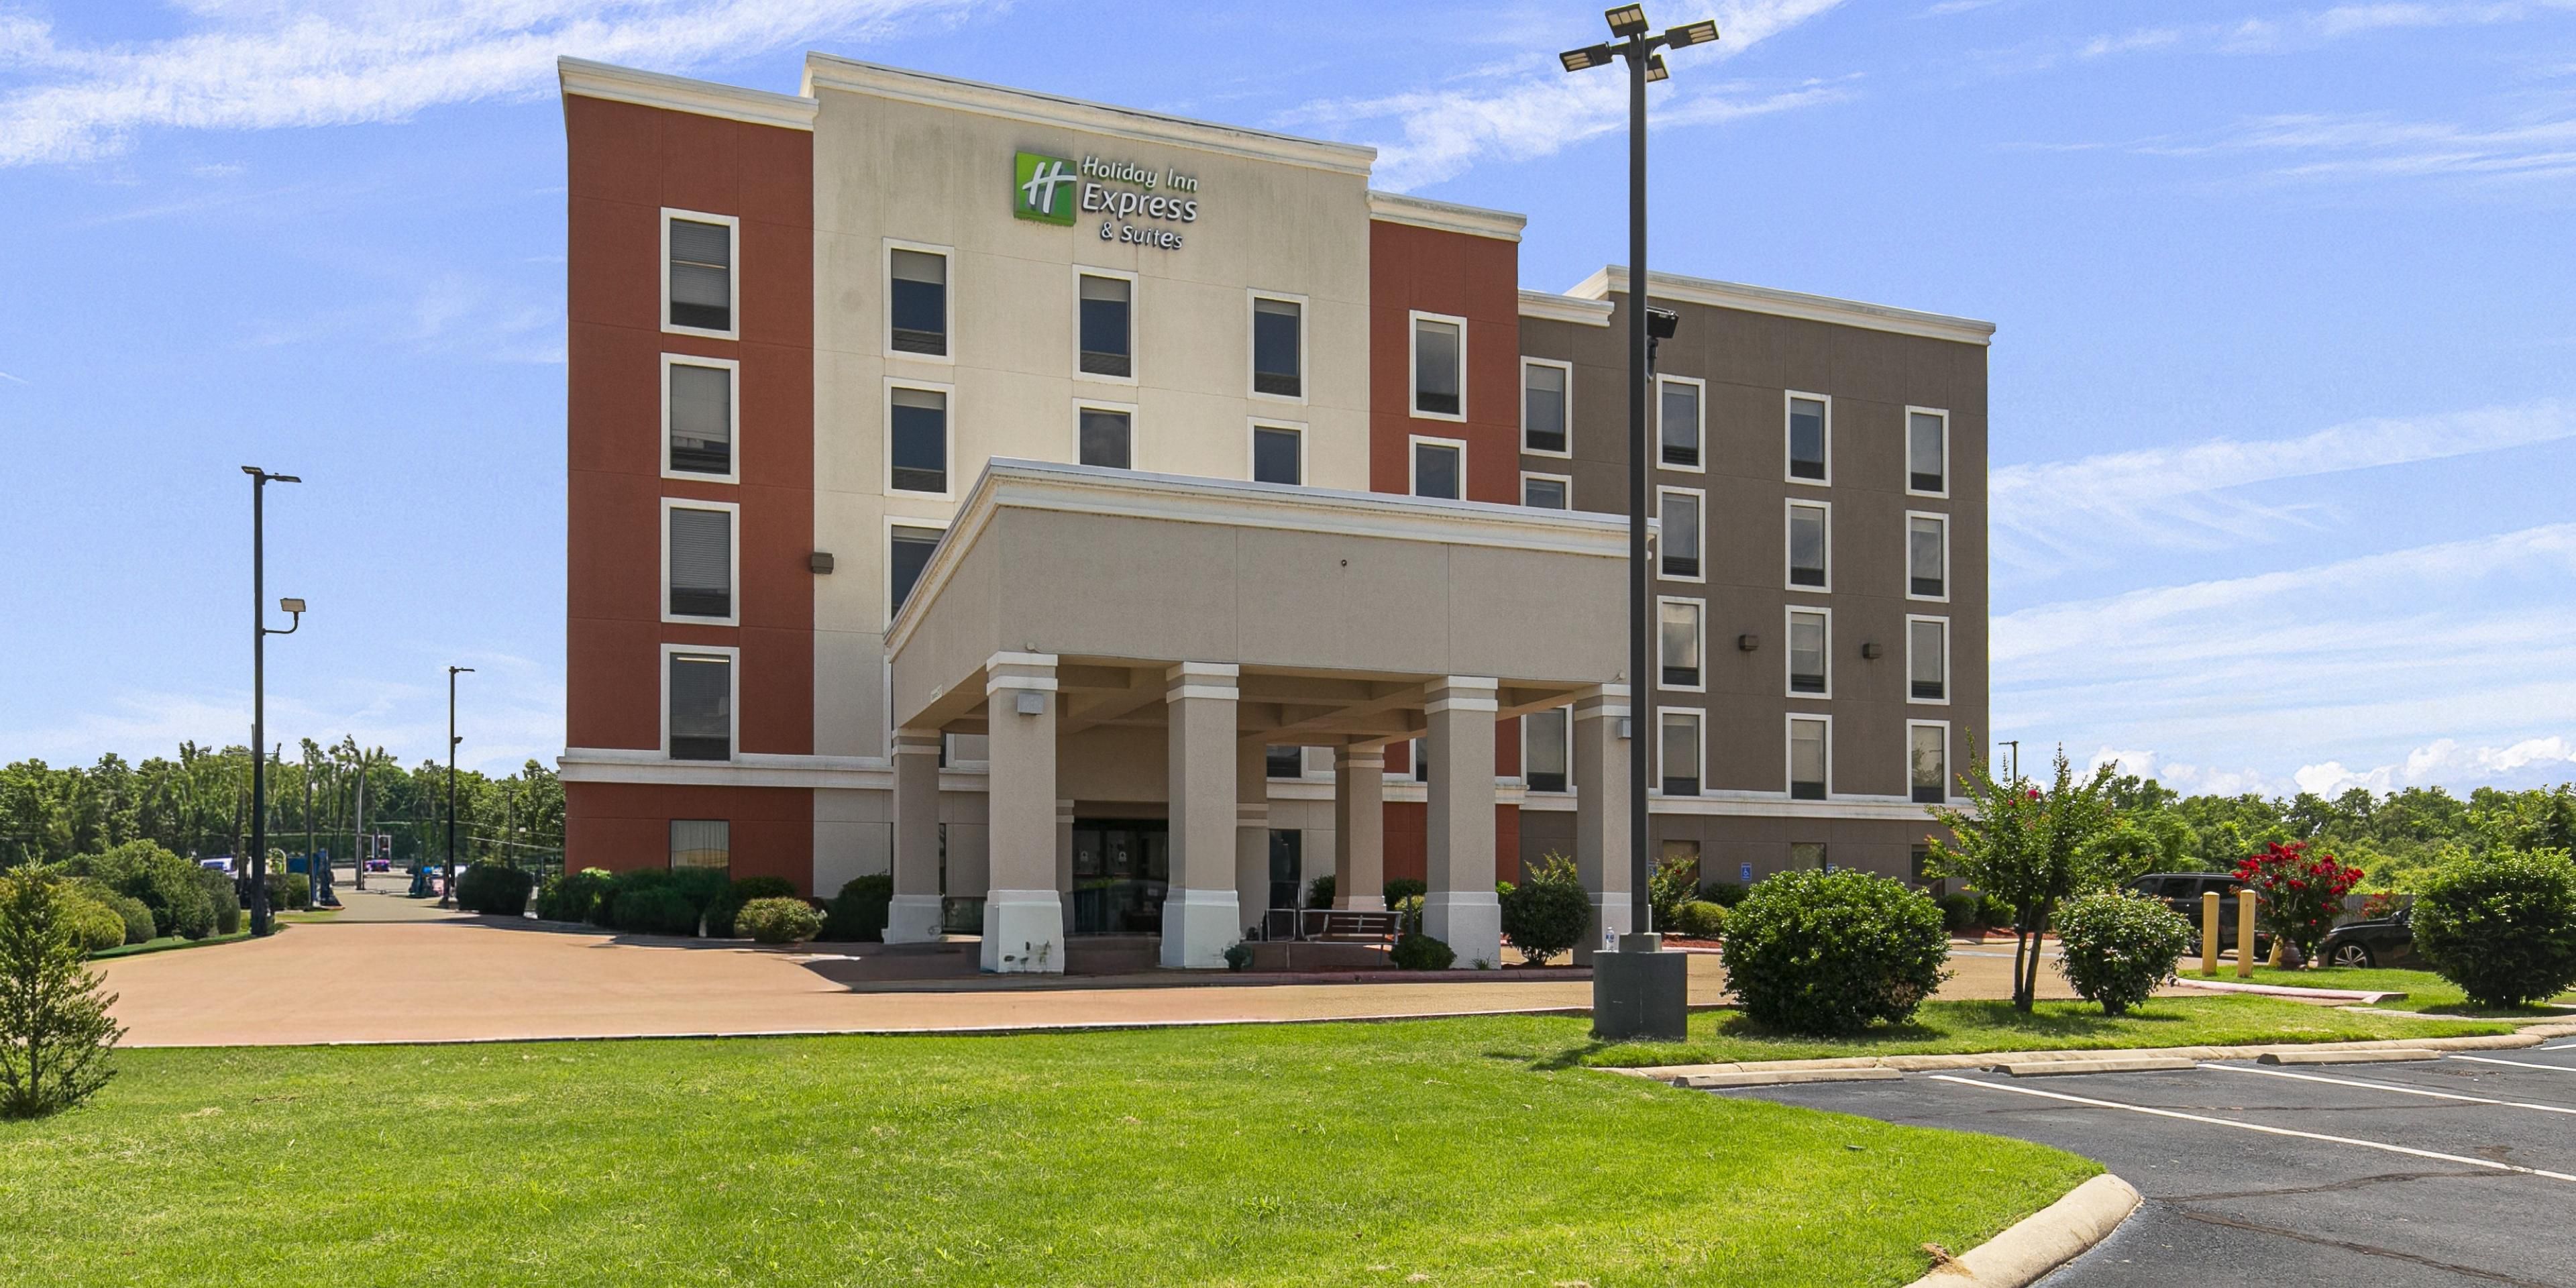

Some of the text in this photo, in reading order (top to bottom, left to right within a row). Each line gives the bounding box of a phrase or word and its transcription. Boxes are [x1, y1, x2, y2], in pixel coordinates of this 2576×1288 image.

[1083, 156, 1198, 192] Holiday Inn
[1083, 182, 1197, 221] Express
[1102, 222, 1183, 248] & Suites
